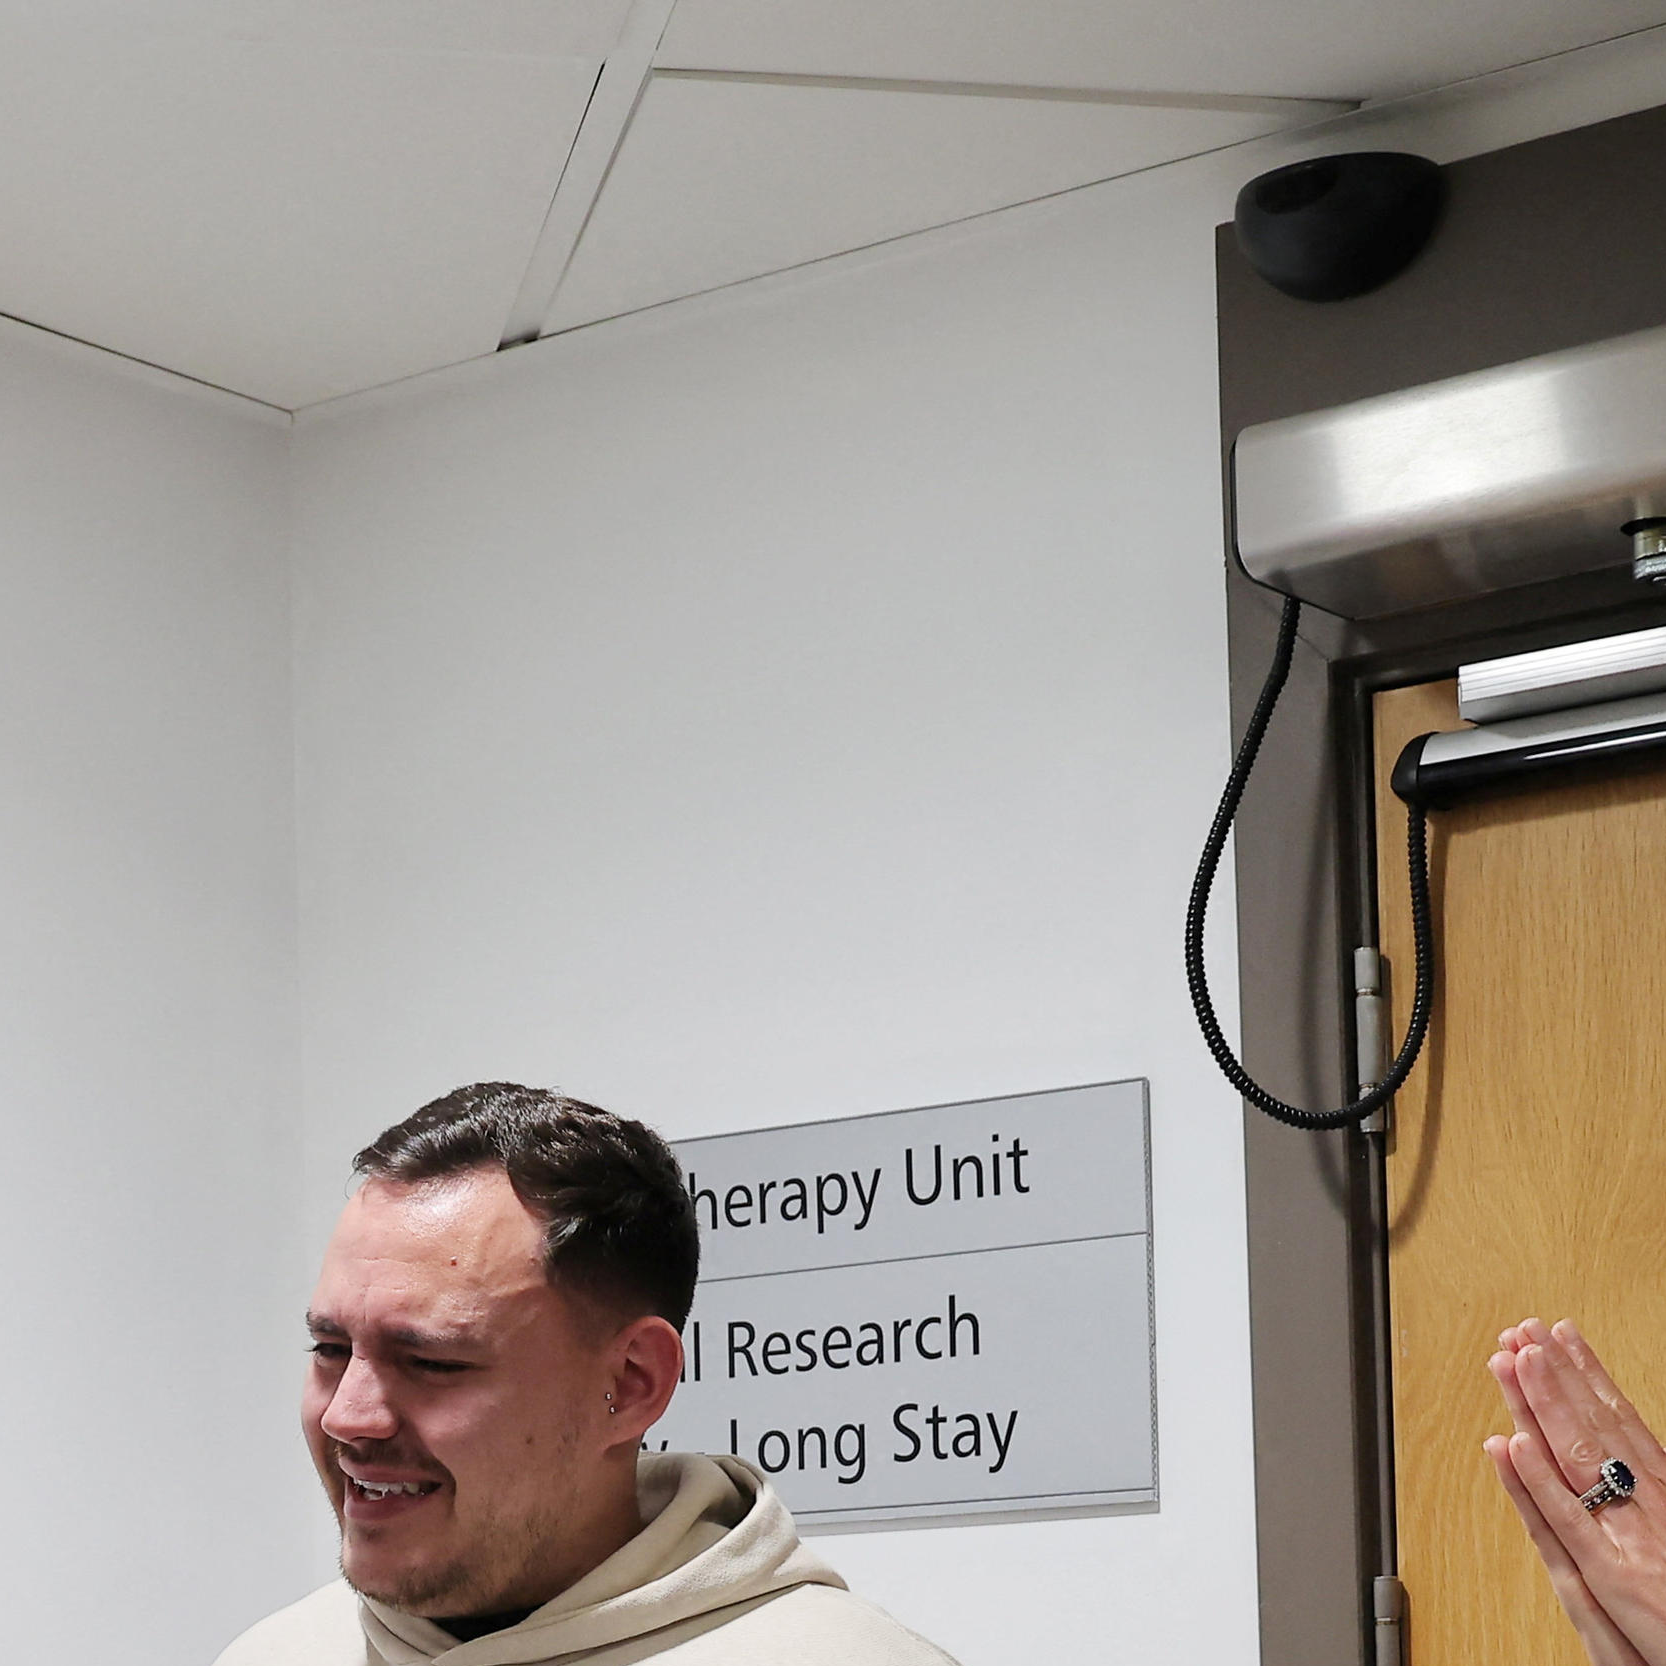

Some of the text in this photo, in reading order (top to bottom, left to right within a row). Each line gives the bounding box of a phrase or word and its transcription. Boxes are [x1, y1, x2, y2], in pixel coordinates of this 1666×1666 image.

[905, 1134, 1030, 1206] Unit
[727, 1295, 981, 1379] Research
[893, 1403, 1018, 1472] Stay
